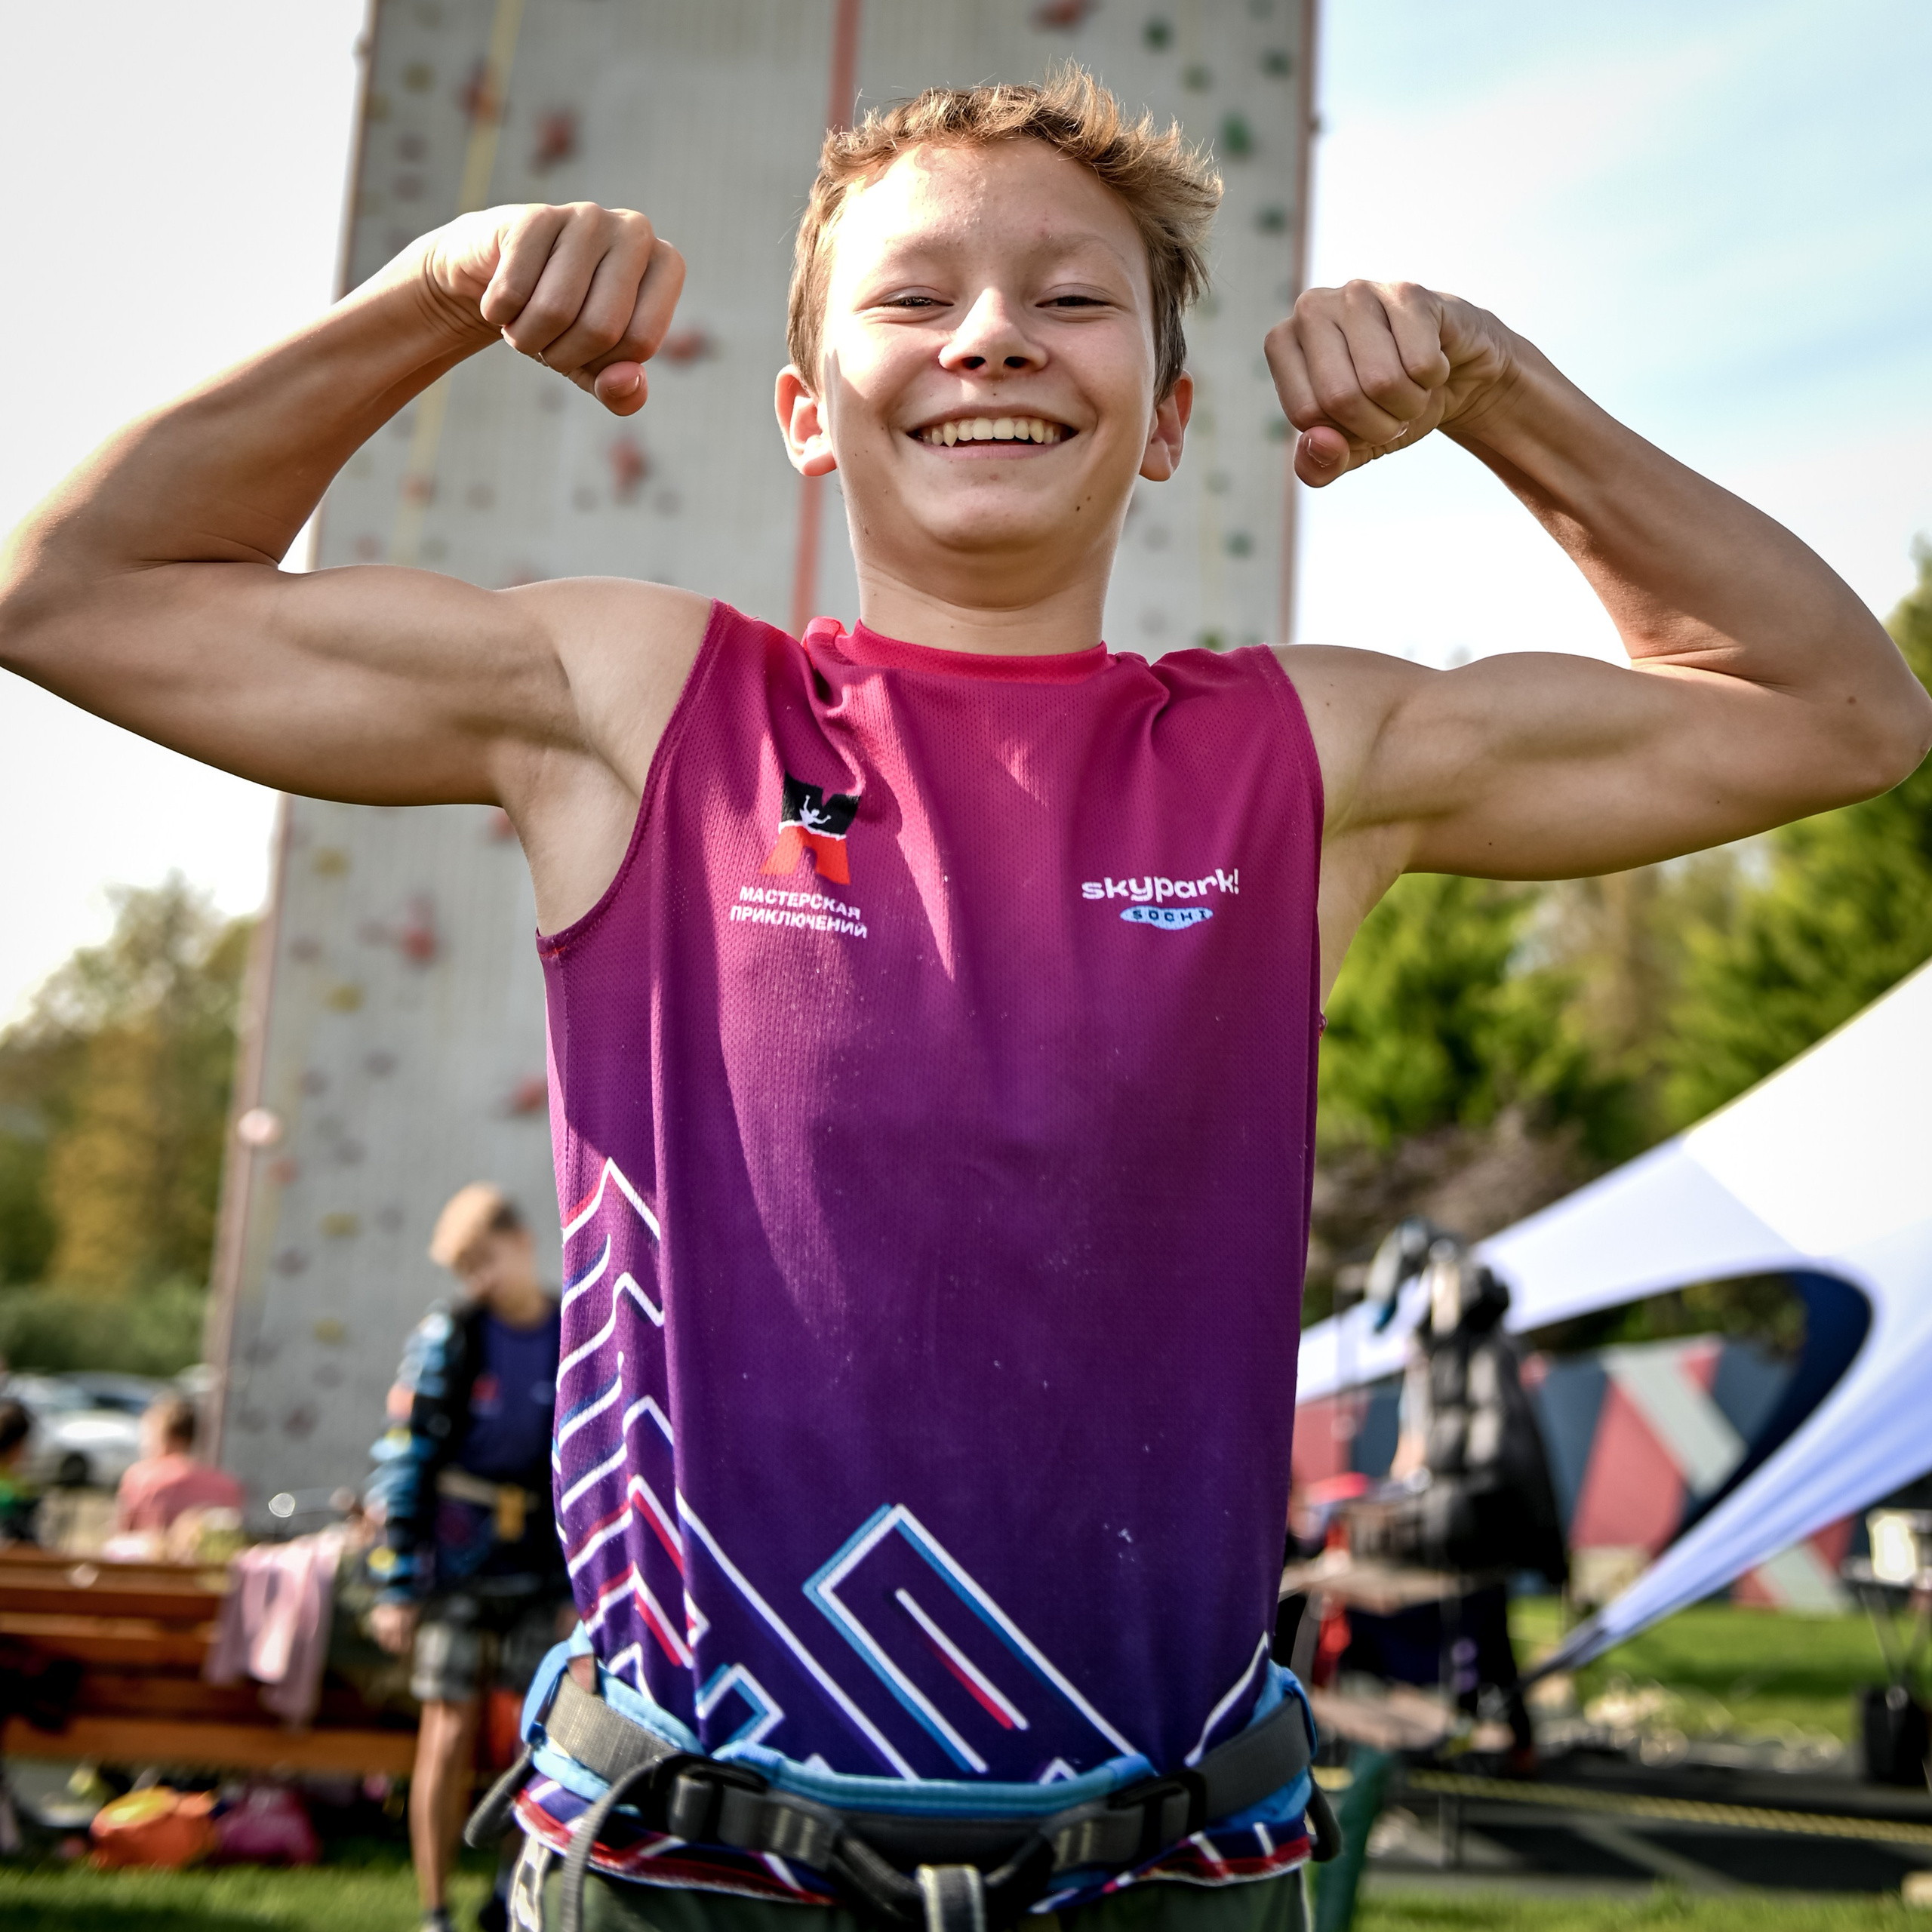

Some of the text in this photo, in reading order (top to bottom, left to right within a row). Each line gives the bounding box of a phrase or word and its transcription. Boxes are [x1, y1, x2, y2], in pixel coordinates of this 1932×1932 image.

[1081, 868, 1239, 903] skypark!
[740, 886, 861, 920] МАСТЕРСКАЯ
[1132, 909, 1208, 922] SOCHI
[730, 905, 867, 939] ПРИКЛЮЧЕНИЙ
